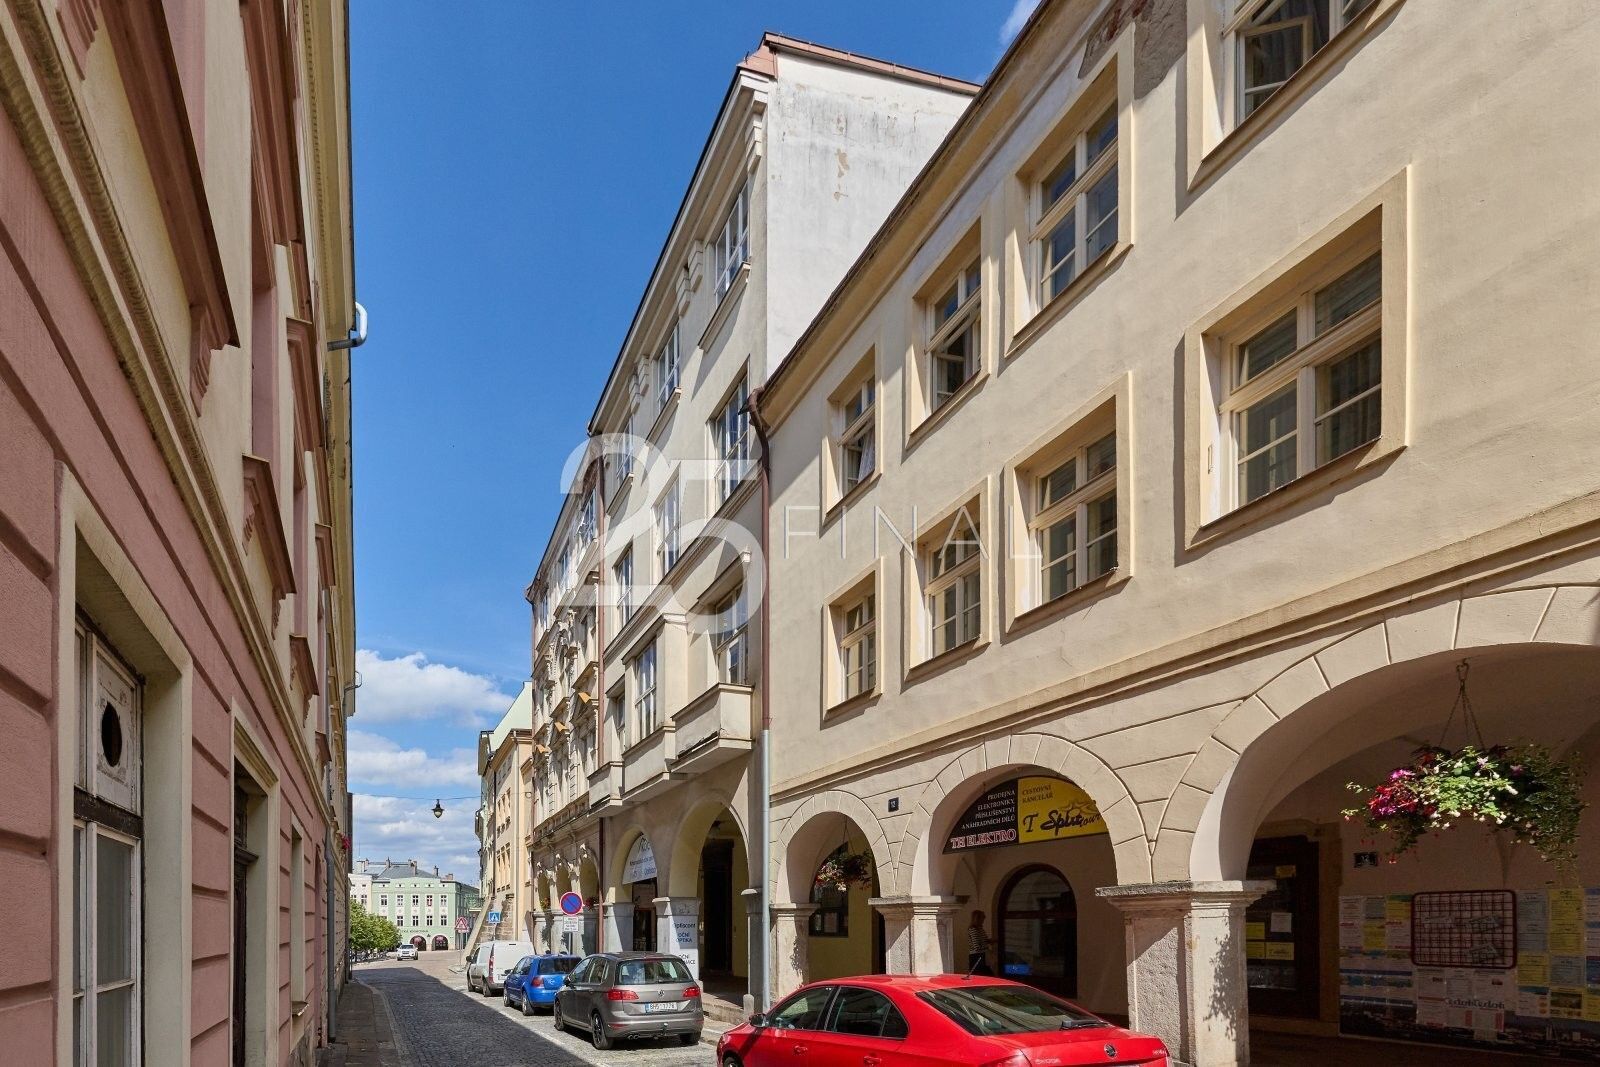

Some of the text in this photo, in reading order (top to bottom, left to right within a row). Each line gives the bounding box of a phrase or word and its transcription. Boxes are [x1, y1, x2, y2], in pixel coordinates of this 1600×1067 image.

[987, 789, 1016, 800] PRODEJNA
[1022, 813, 1039, 833] T
[966, 828, 1017, 847] ELEKTRO
